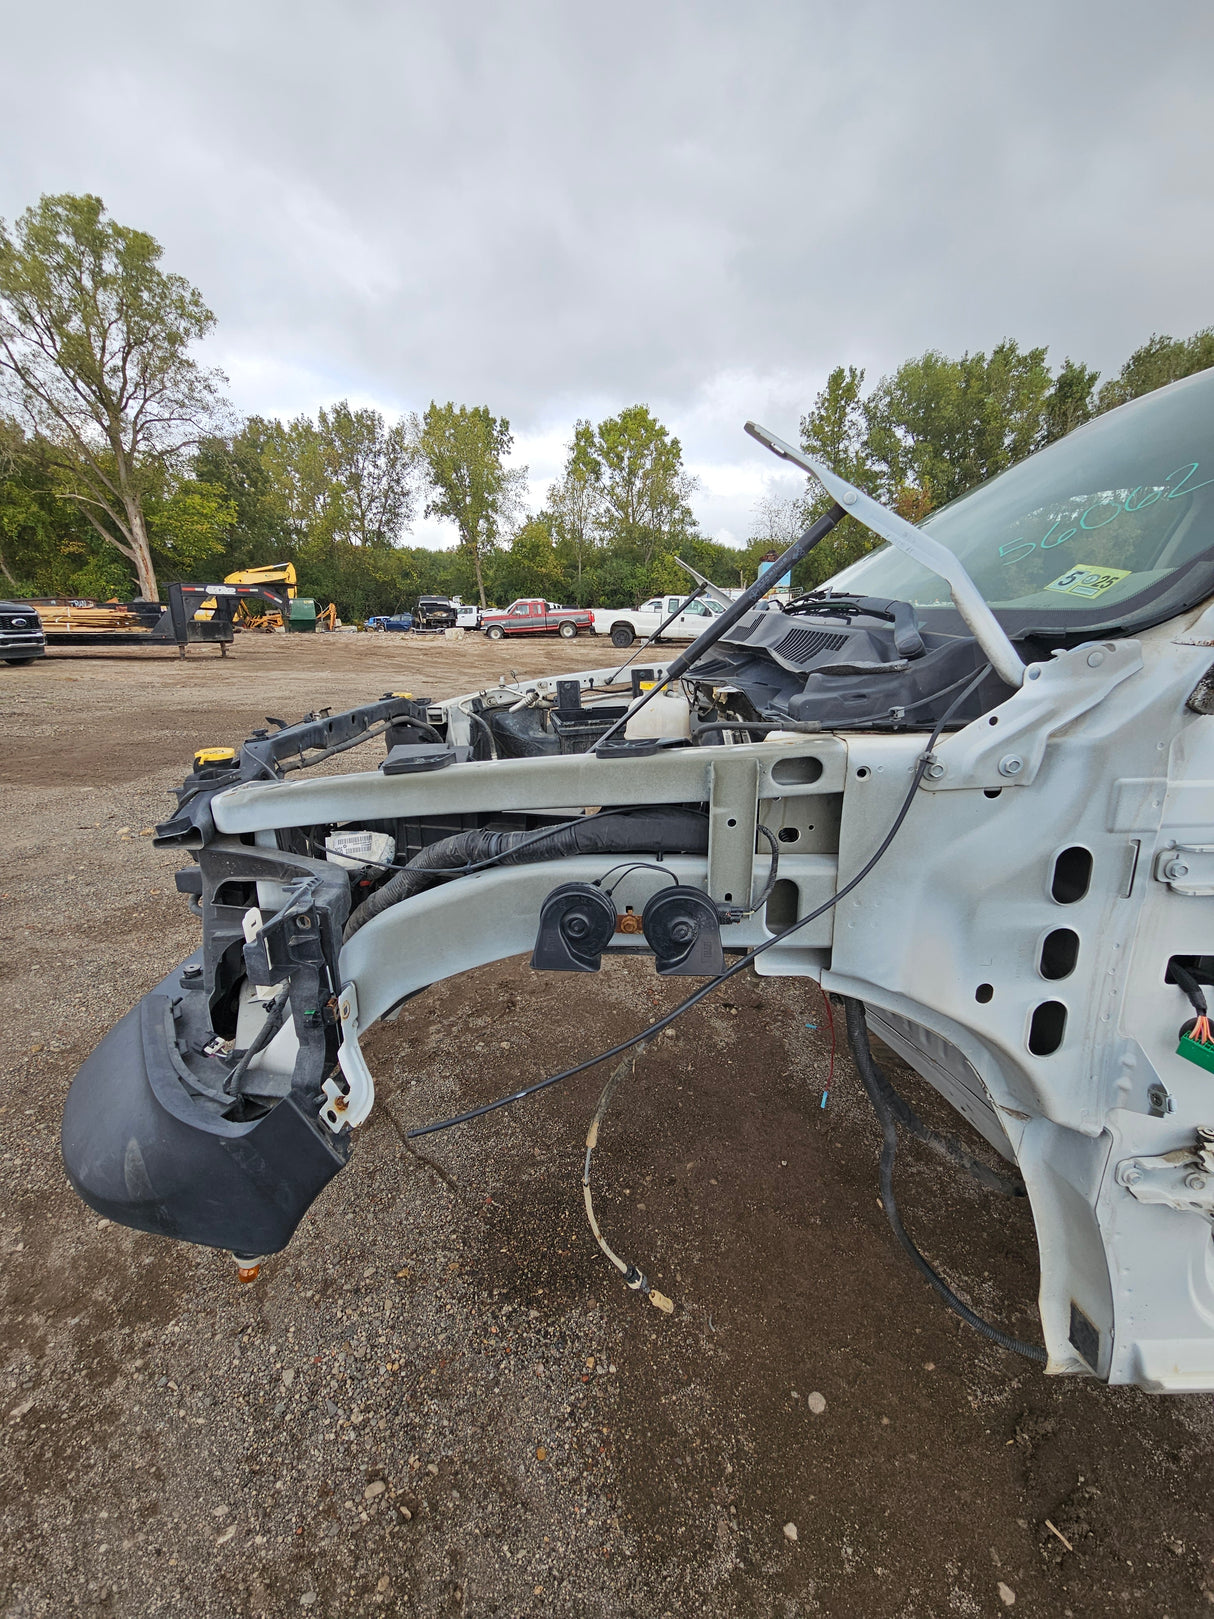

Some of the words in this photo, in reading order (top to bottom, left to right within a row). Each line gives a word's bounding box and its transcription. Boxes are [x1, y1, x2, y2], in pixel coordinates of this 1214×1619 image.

[999, 463, 1214, 566] 56062
[1058, 571, 1084, 586] 5
[1091, 575, 1119, 589] 25
